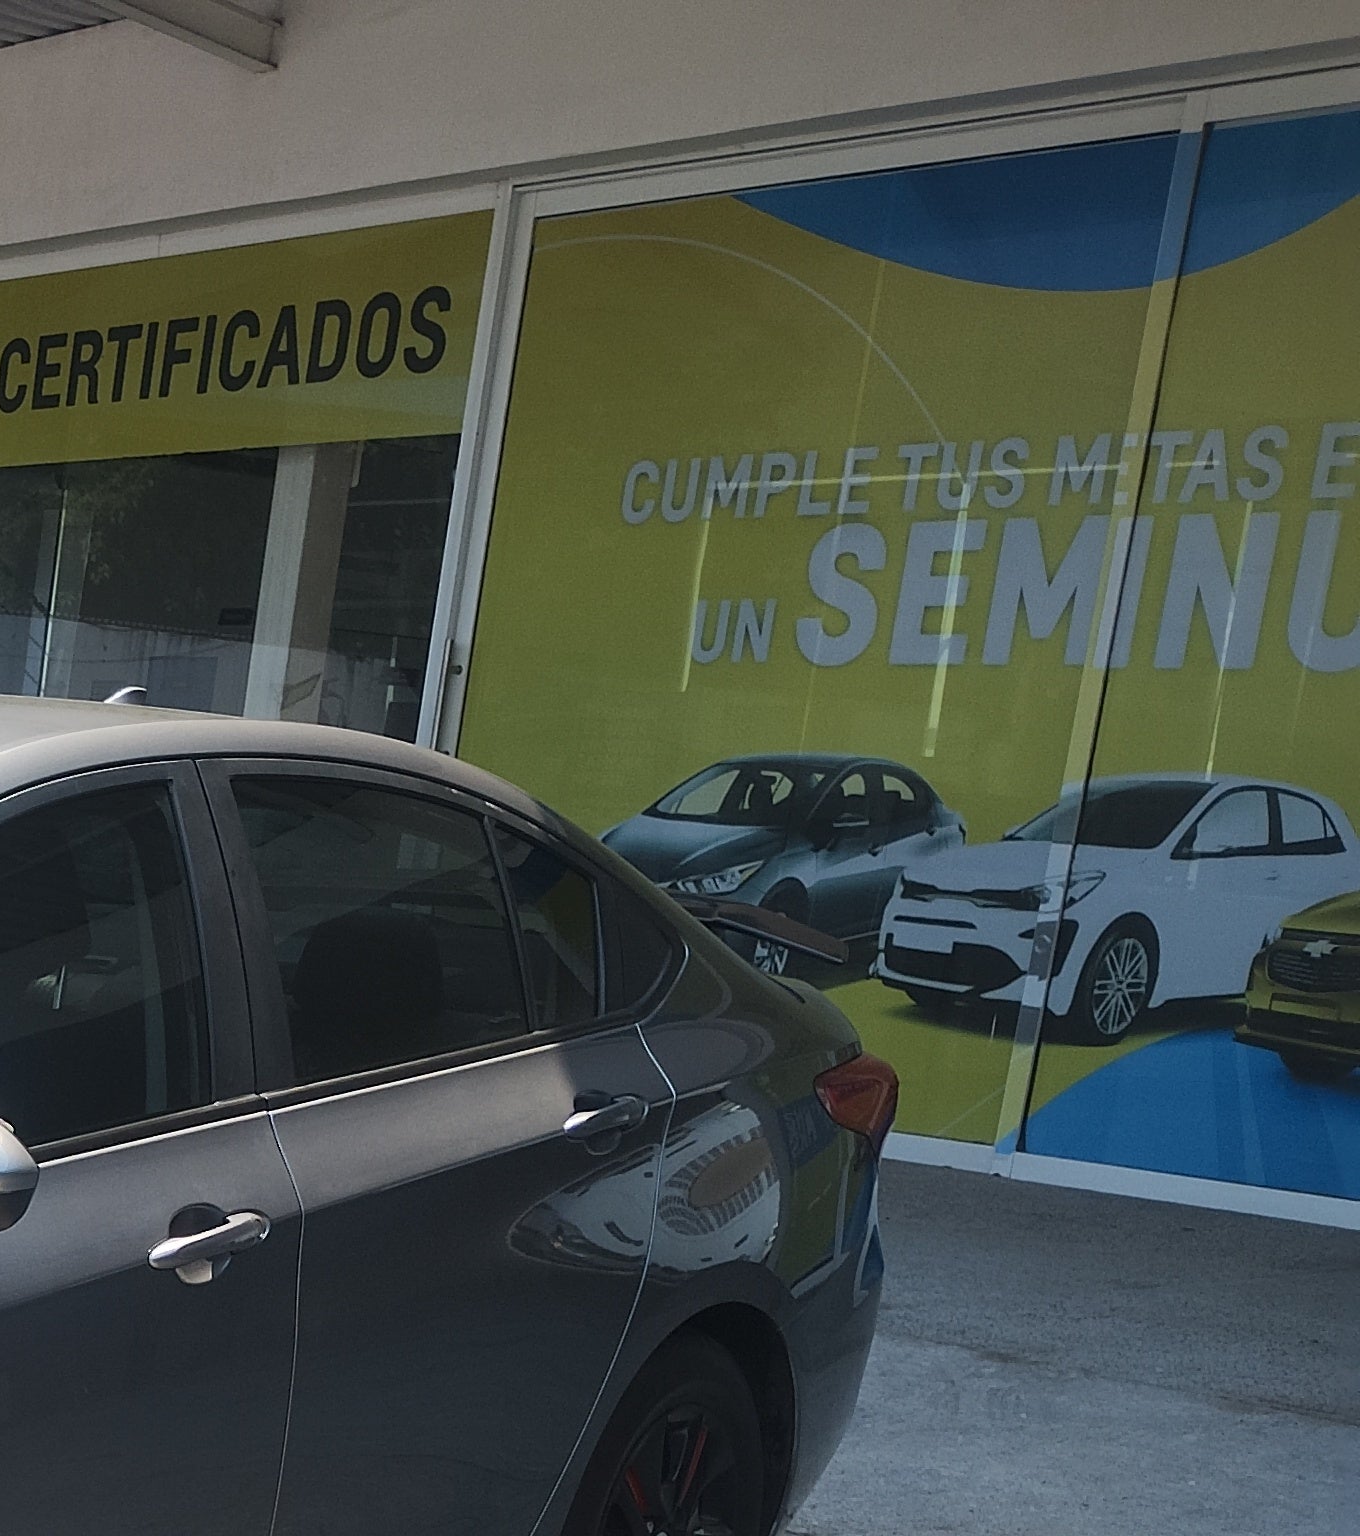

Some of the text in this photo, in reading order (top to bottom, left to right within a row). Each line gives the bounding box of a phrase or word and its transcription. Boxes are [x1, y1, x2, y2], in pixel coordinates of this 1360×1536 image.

[621, 446, 880, 525] CUMPLE
[897, 437, 1031, 512] TUS
[689, 599, 777, 664] UN
